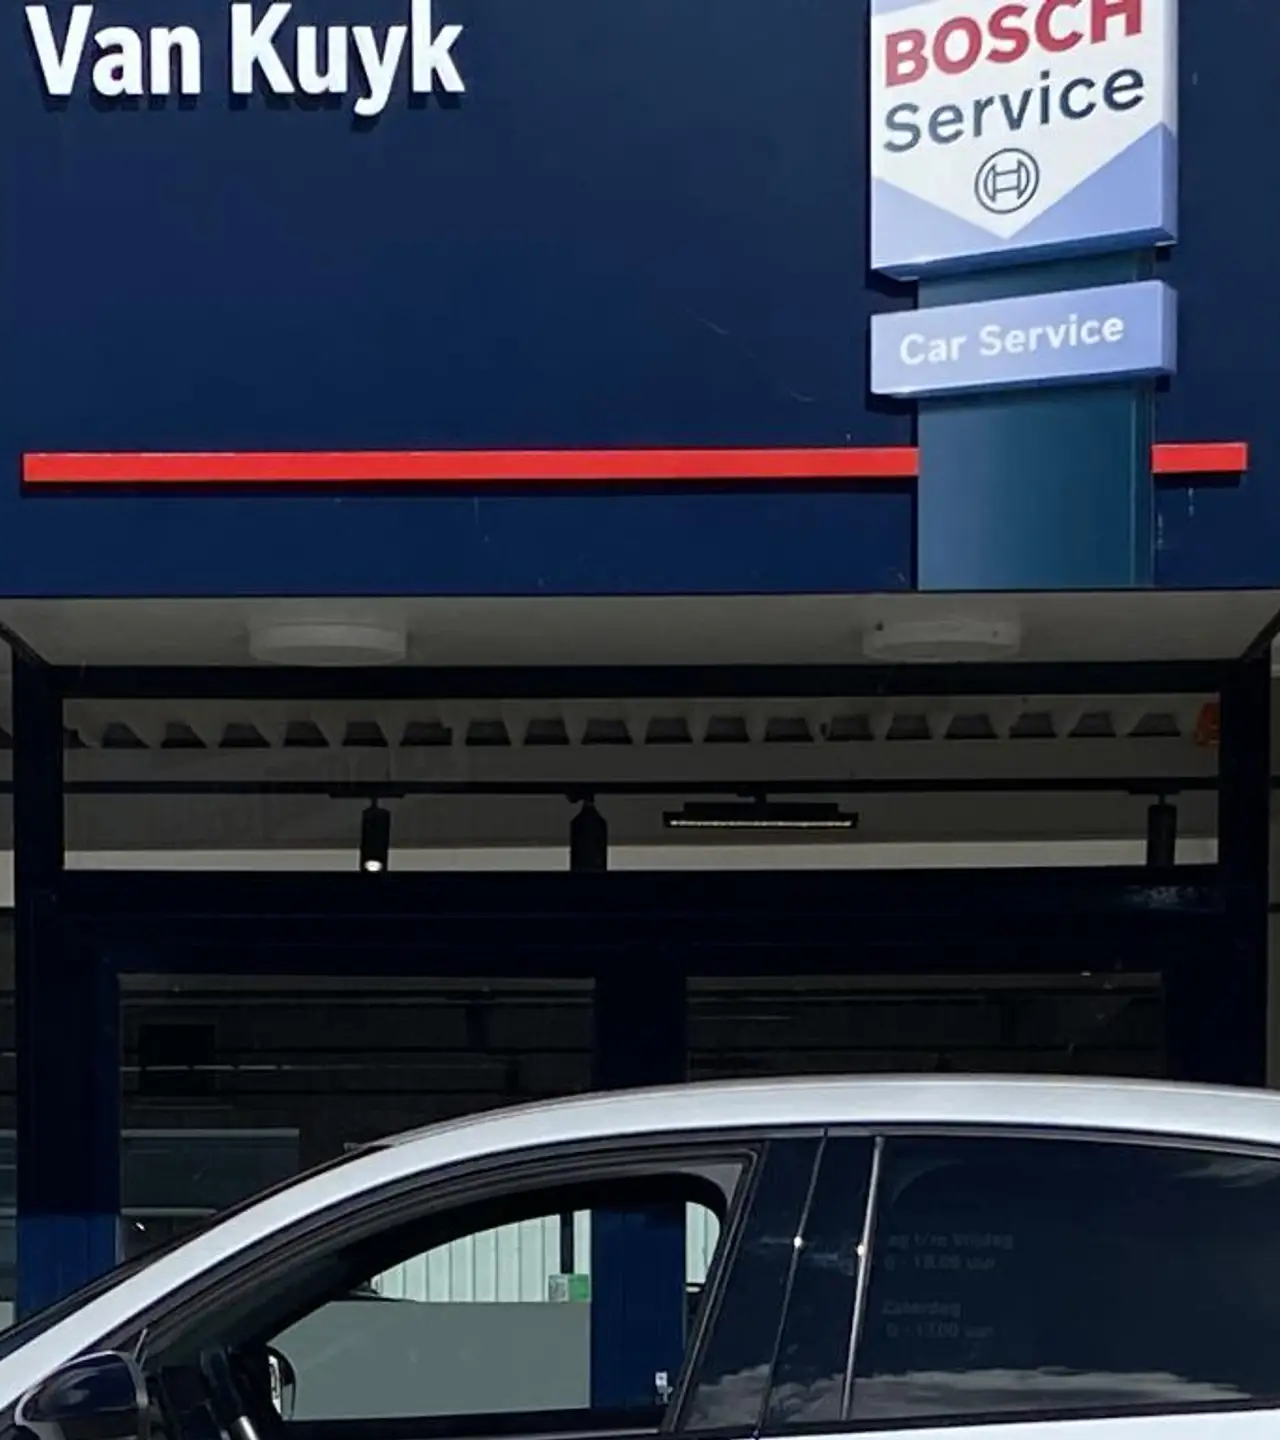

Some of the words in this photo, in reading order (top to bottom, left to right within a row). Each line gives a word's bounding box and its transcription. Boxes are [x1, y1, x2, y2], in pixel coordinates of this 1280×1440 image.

[25, 4, 201, 95] Van
[231, 0, 466, 116] Kuyk
[885, 0, 1142, 88] BOSCH
[883, 68, 1145, 153] Service
[899, 333, 967, 366] Car
[979, 313, 1125, 357] Service
